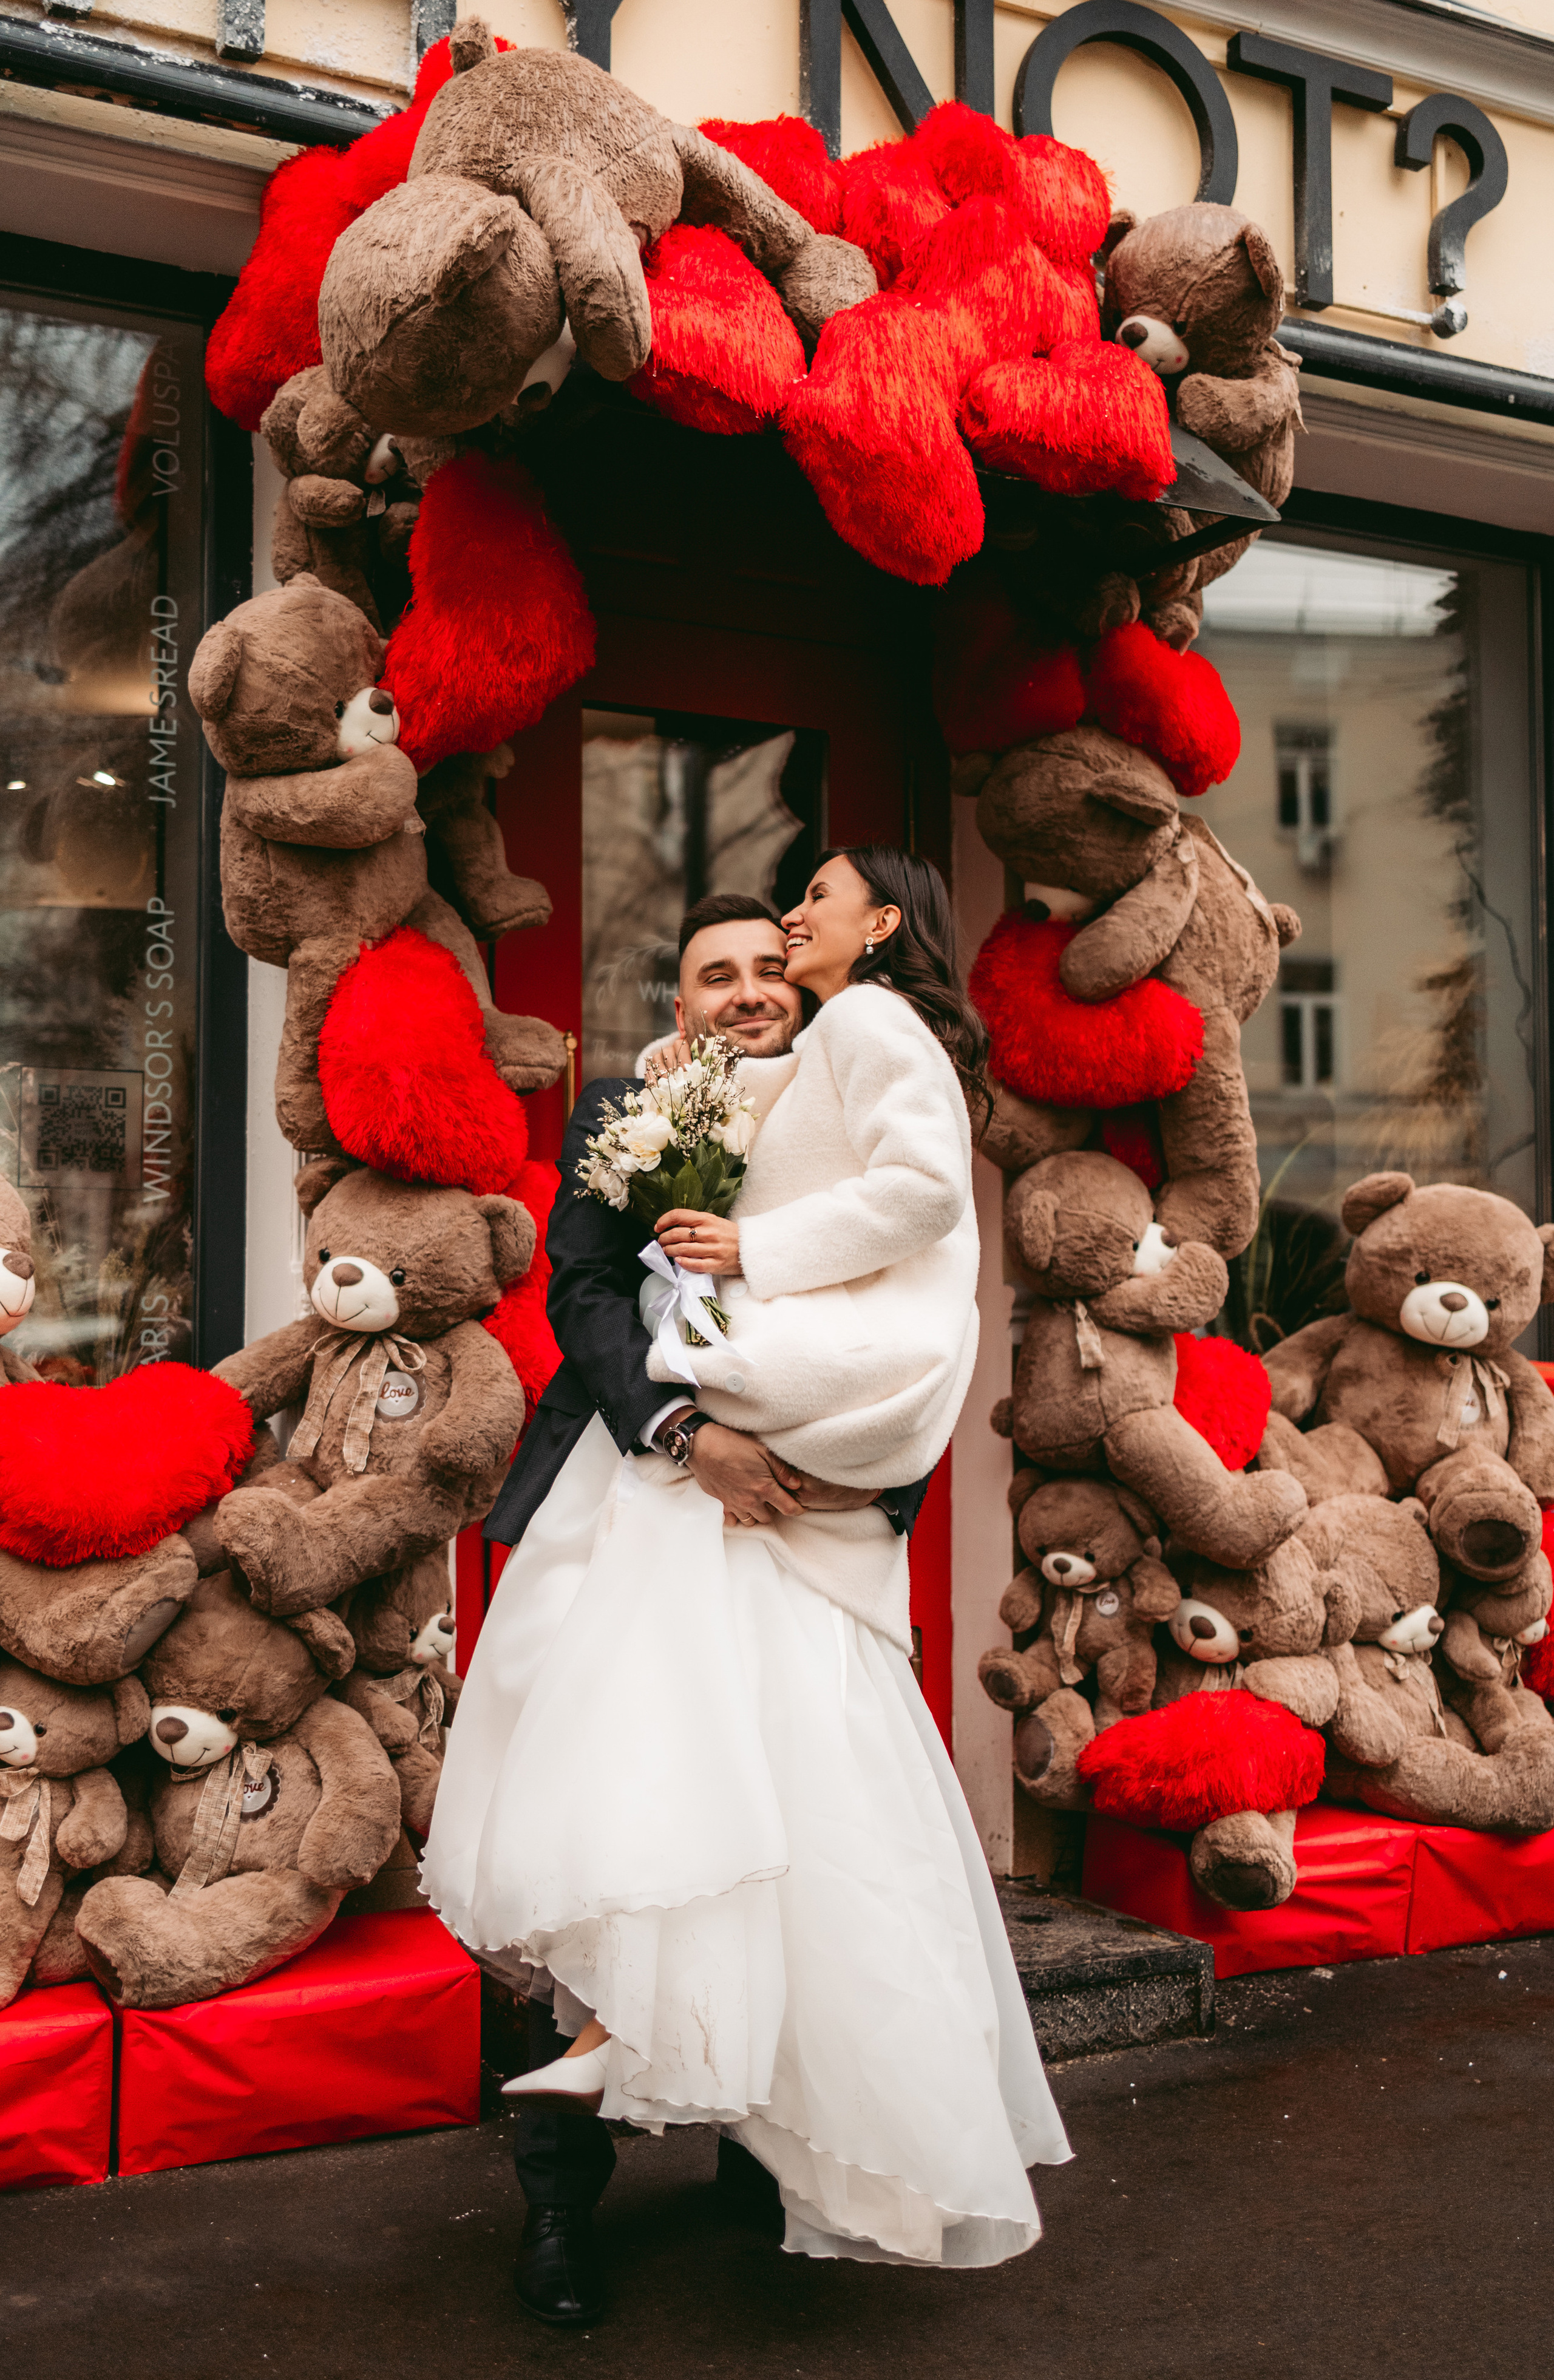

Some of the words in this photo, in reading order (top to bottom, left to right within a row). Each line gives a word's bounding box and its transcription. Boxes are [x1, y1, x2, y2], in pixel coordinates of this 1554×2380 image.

[152, 339, 183, 497] VOLUSPA
[146, 897, 175, 990] SOAP
[638, 980, 679, 1004] WH
[143, 1001, 174, 1203] WINDSOR'S
[140, 1294, 169, 1365] ARIS
[243, 1782, 267, 1794] ove
